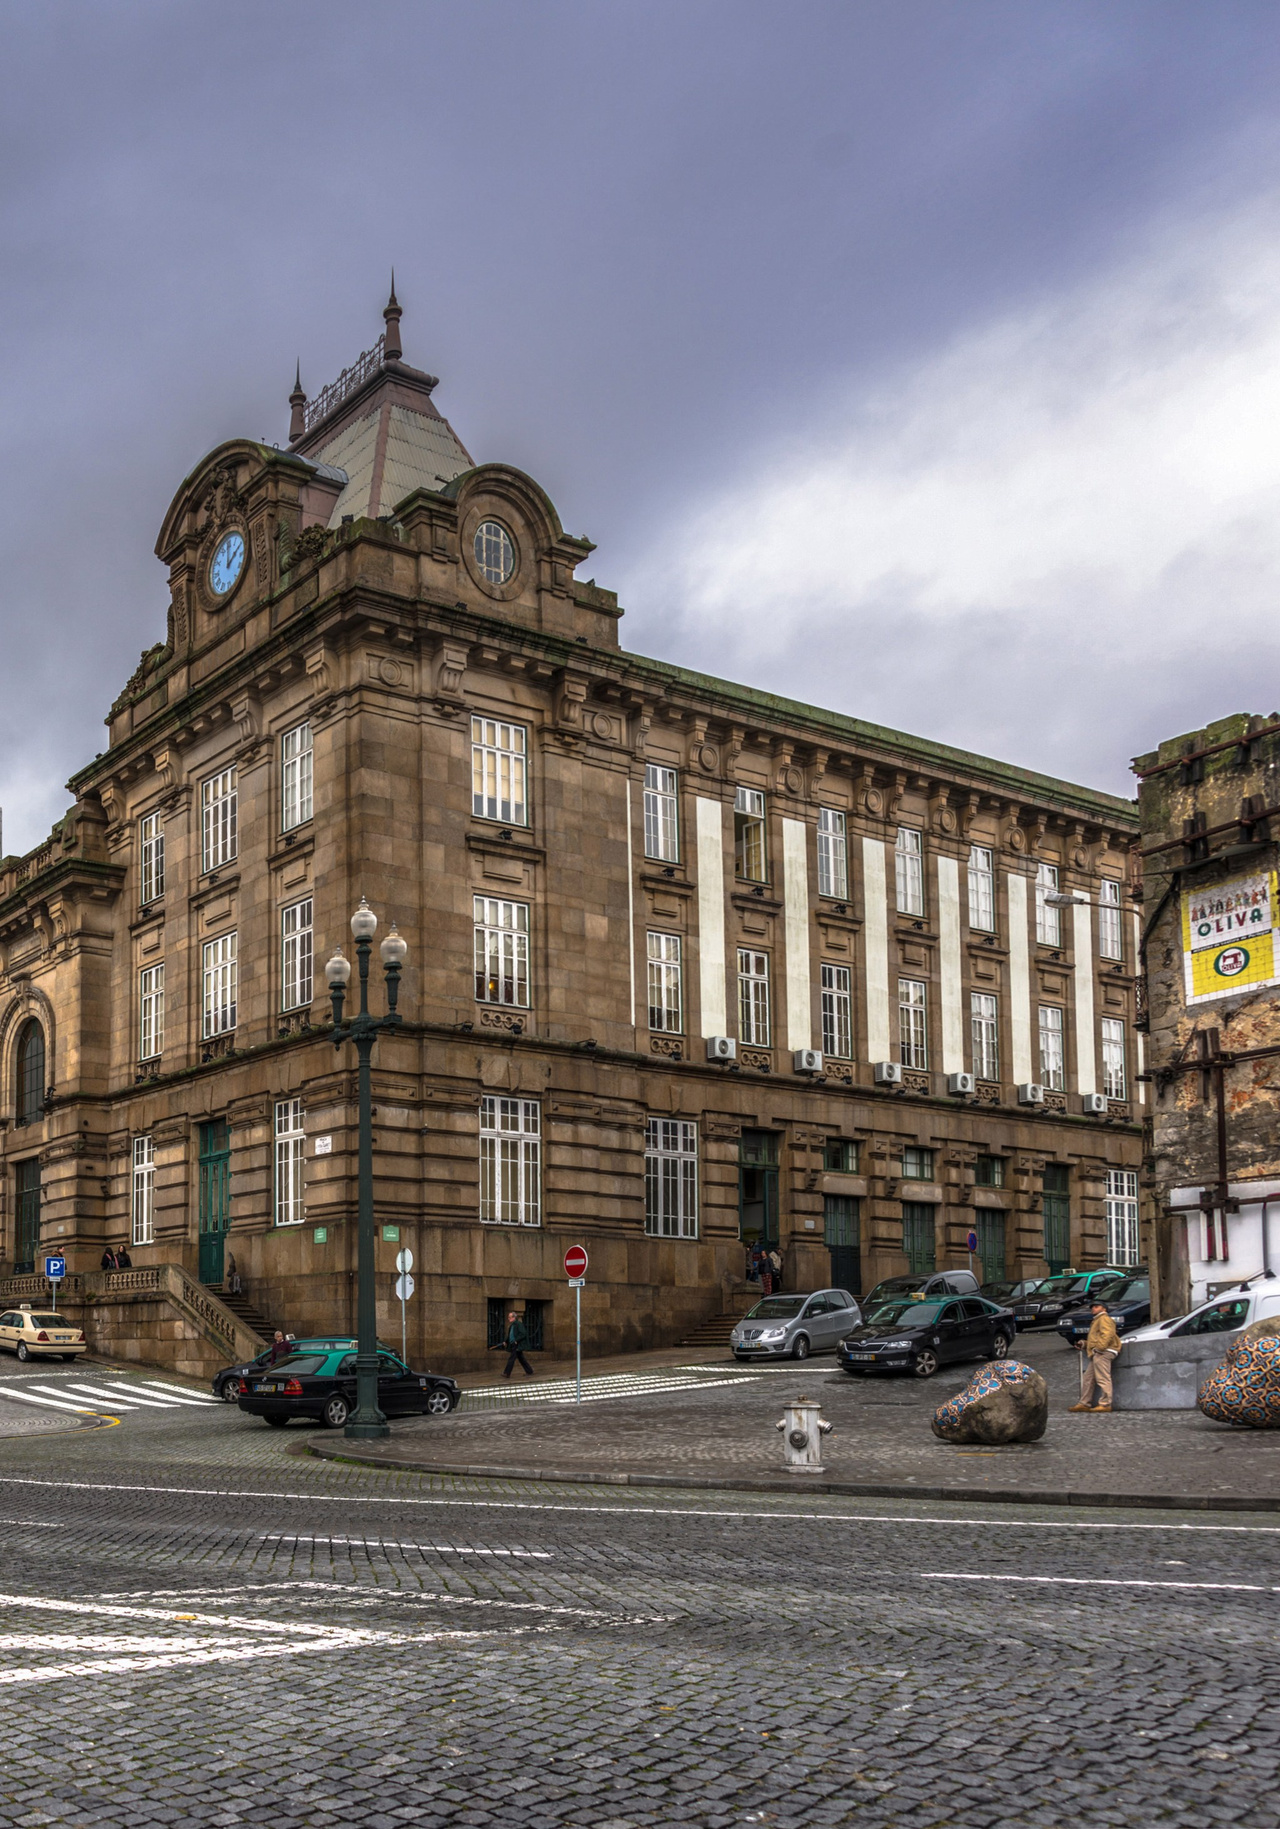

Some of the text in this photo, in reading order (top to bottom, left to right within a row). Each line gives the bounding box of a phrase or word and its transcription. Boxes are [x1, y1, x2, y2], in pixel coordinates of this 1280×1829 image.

[1198, 908, 1263, 936] OLIVA
[1222, 961, 1243, 972] OLIVA
[50, 1260, 60, 1274] P
